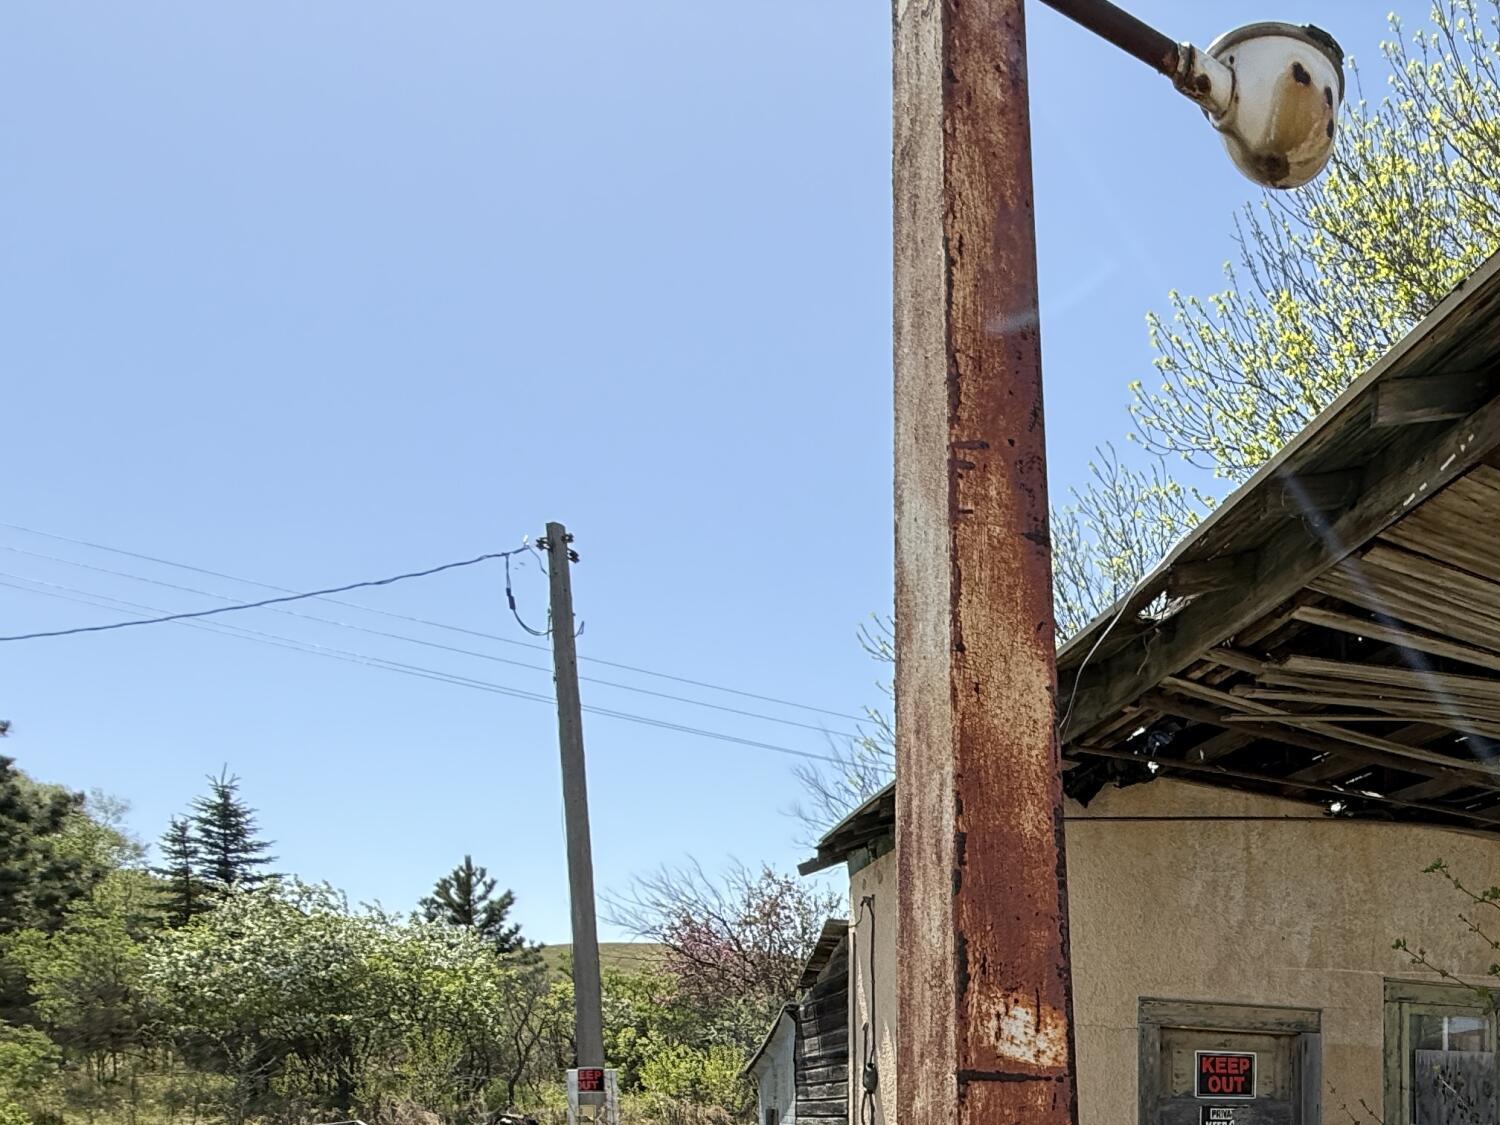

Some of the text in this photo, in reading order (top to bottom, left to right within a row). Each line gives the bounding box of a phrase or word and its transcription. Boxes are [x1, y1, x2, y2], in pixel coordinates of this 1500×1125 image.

[1202, 1056, 1250, 1075] KEEP
[578, 1070, 602, 1080] EEP
[1208, 1075, 1245, 1093] OUT
